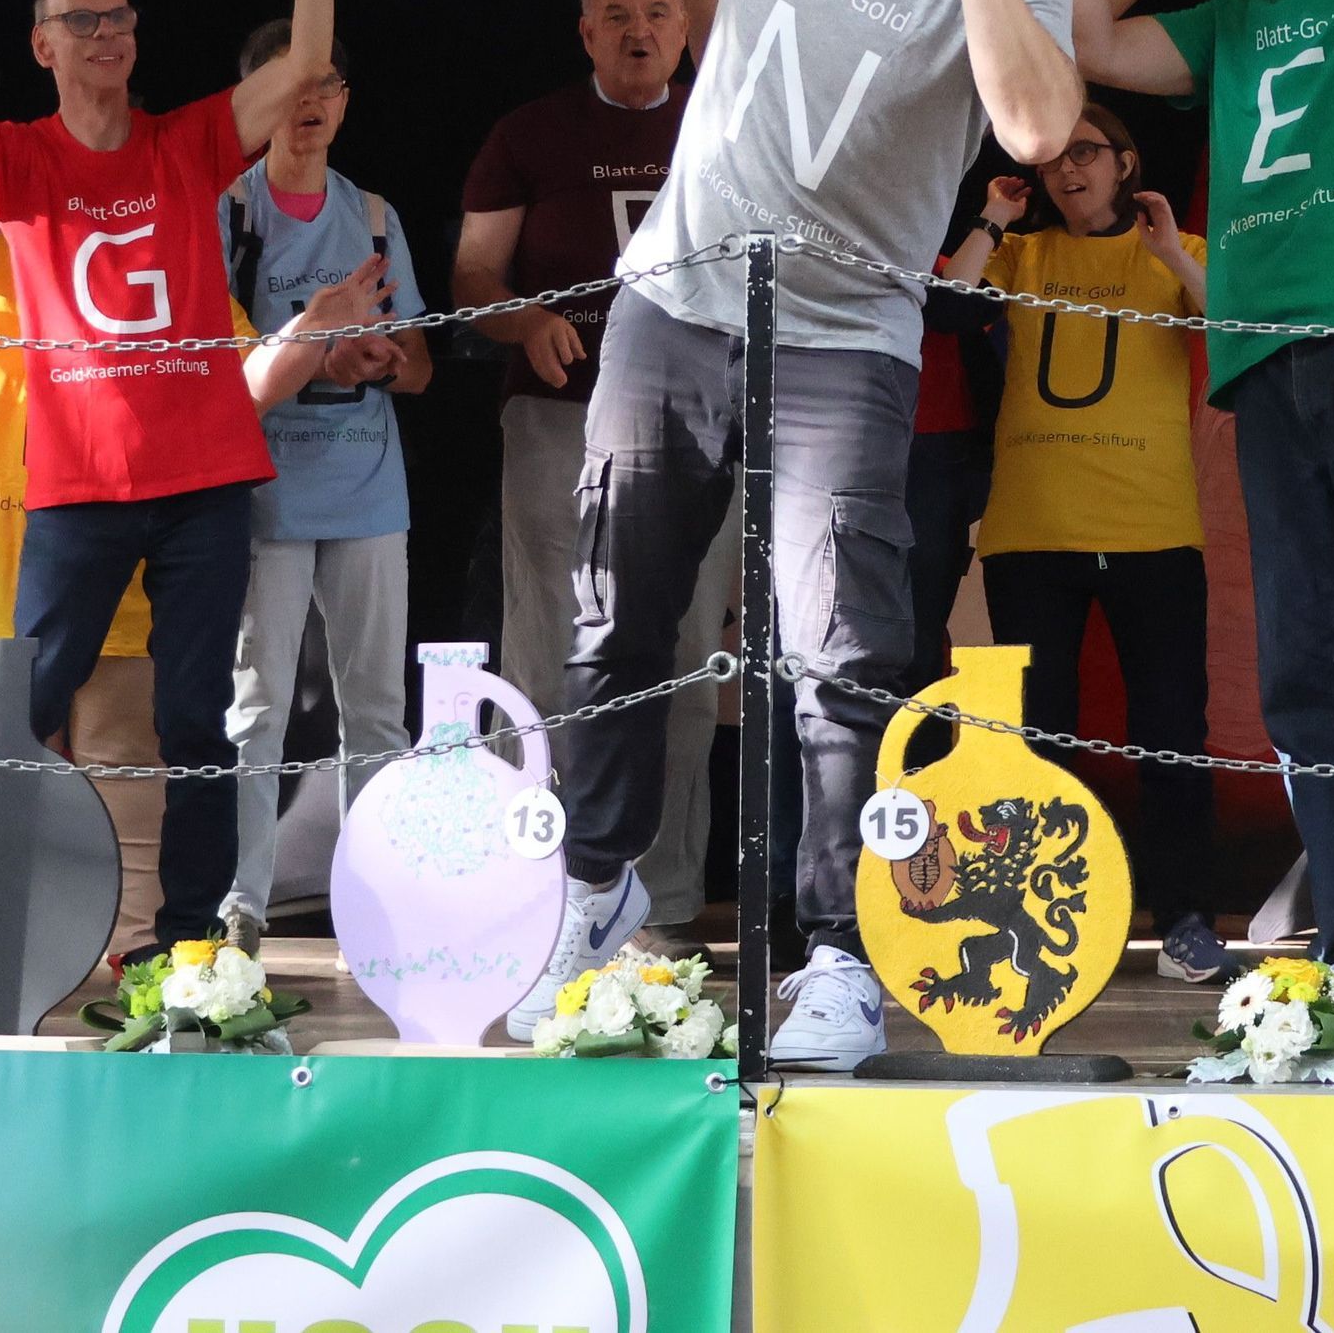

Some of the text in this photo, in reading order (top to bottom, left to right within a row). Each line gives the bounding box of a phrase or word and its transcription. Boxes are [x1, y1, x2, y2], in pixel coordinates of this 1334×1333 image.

[1256, 14, 1334, 50] Blatt-Go
[1241, 47, 1325, 184] E
[593, 164, 670, 179] Blatt-Go
[68, 194, 156, 220] Blatt-Gold
[73, 223, 172, 334] G
[1043, 282, 1126, 300] Blatt-Gold
[50, 357, 210, 383] Gold-Kraemer-Stiftung
[1037, 312, 1119, 409] U
[513, 805, 555, 843] 13
[868, 807, 919, 841] 15
